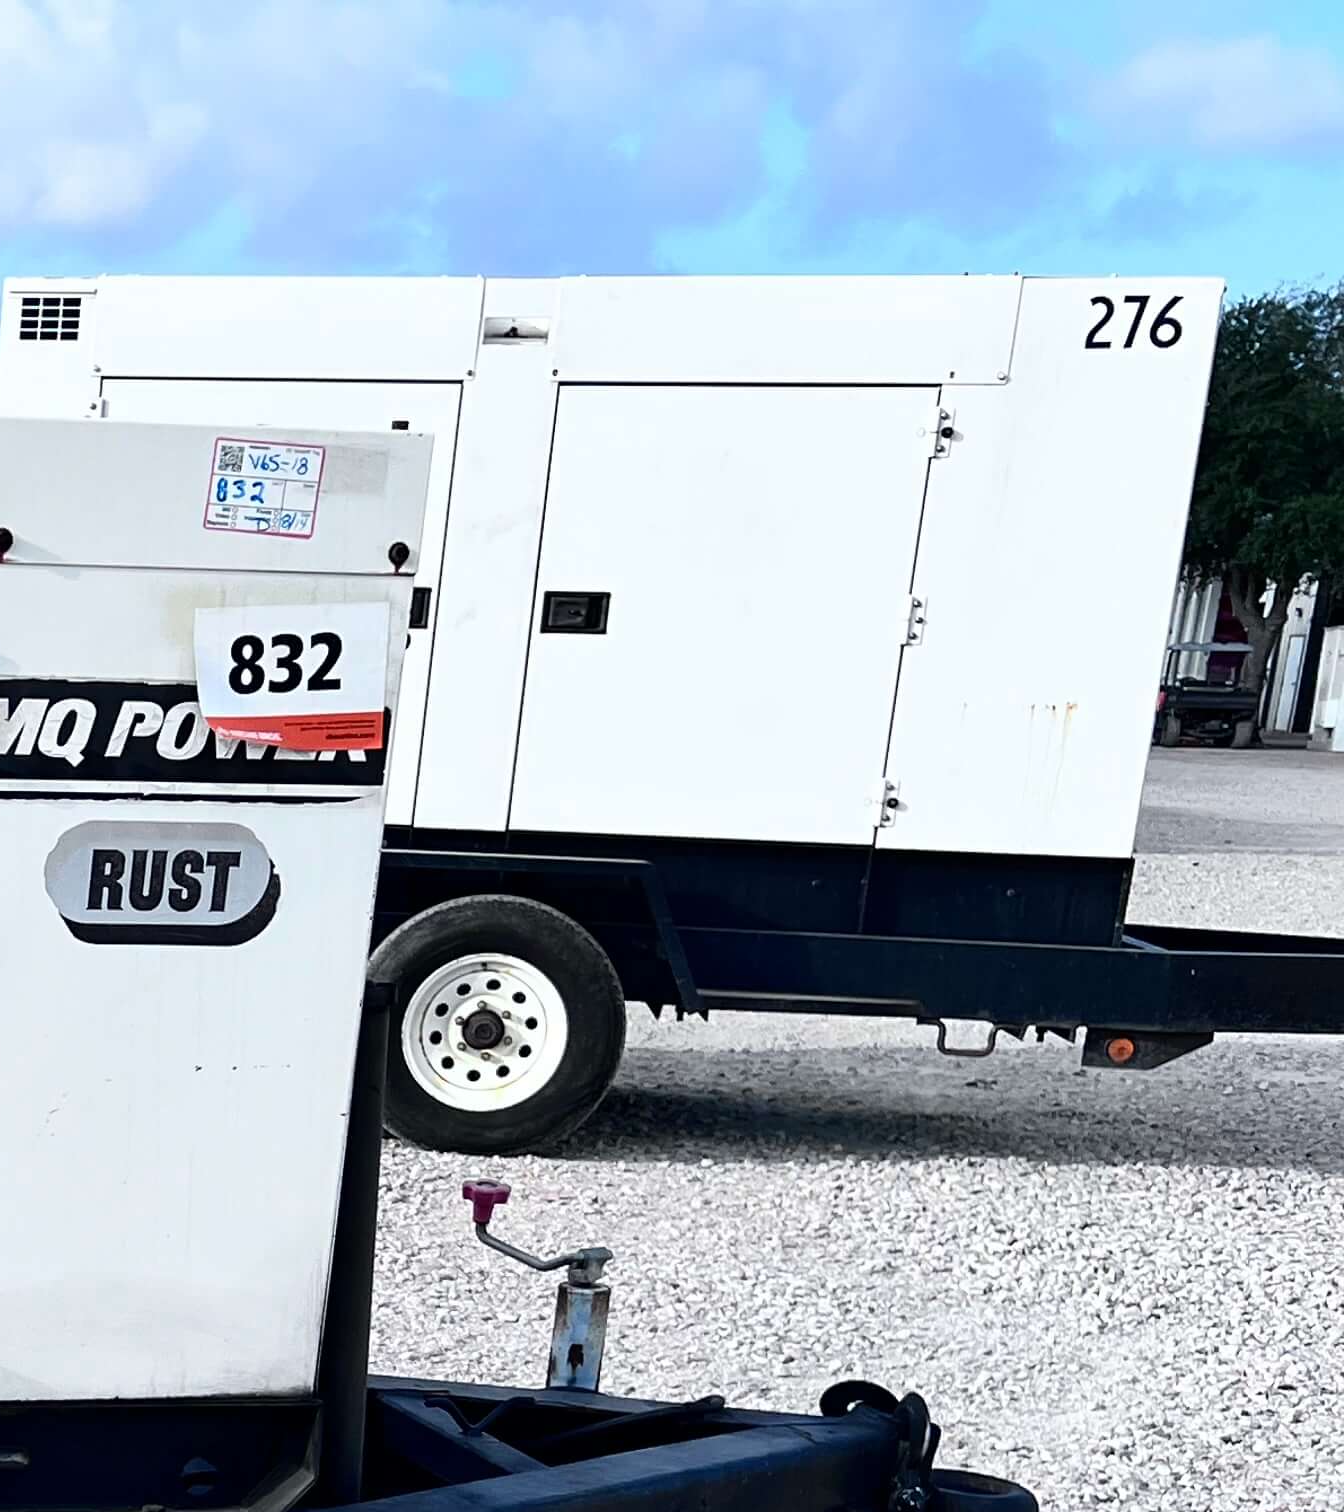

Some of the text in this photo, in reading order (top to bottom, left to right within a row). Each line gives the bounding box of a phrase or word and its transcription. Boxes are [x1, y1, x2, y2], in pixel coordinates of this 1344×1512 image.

[1085, 295, 1184, 349] 276
[216, 477, 265, 504] 832
[228, 631, 343, 695] 832
[86, 848, 242, 912] RUST
